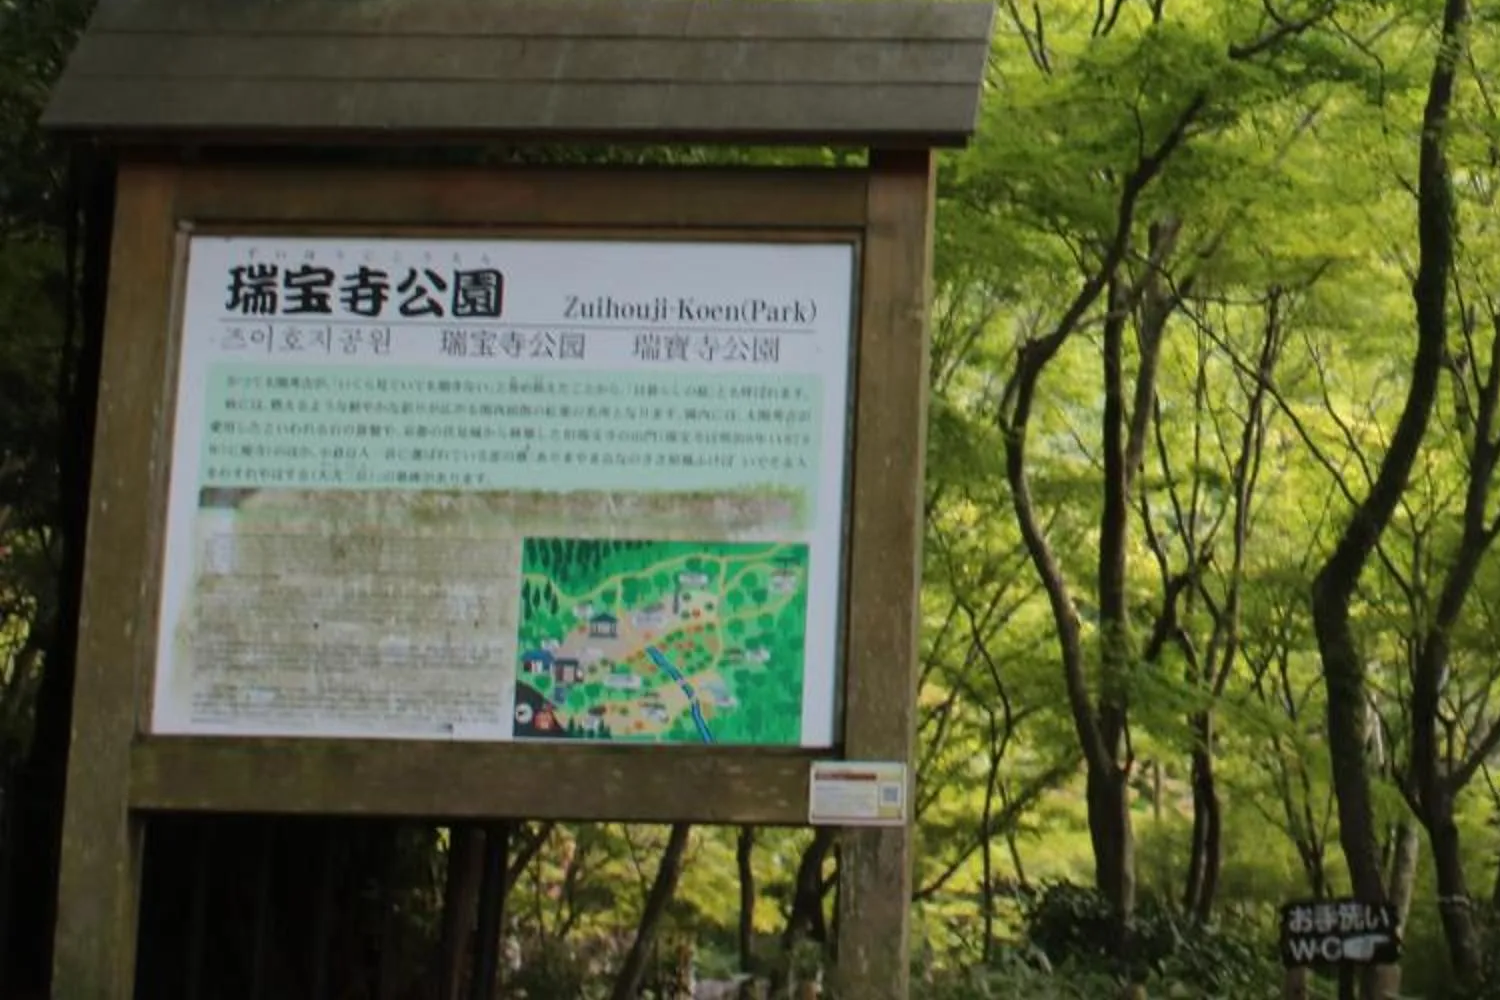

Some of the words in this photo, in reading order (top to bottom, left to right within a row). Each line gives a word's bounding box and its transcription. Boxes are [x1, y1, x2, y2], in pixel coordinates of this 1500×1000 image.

[225, 264, 506, 318] 瑞宝寺公園
[1288, 904, 1390, 934] お手洗い
